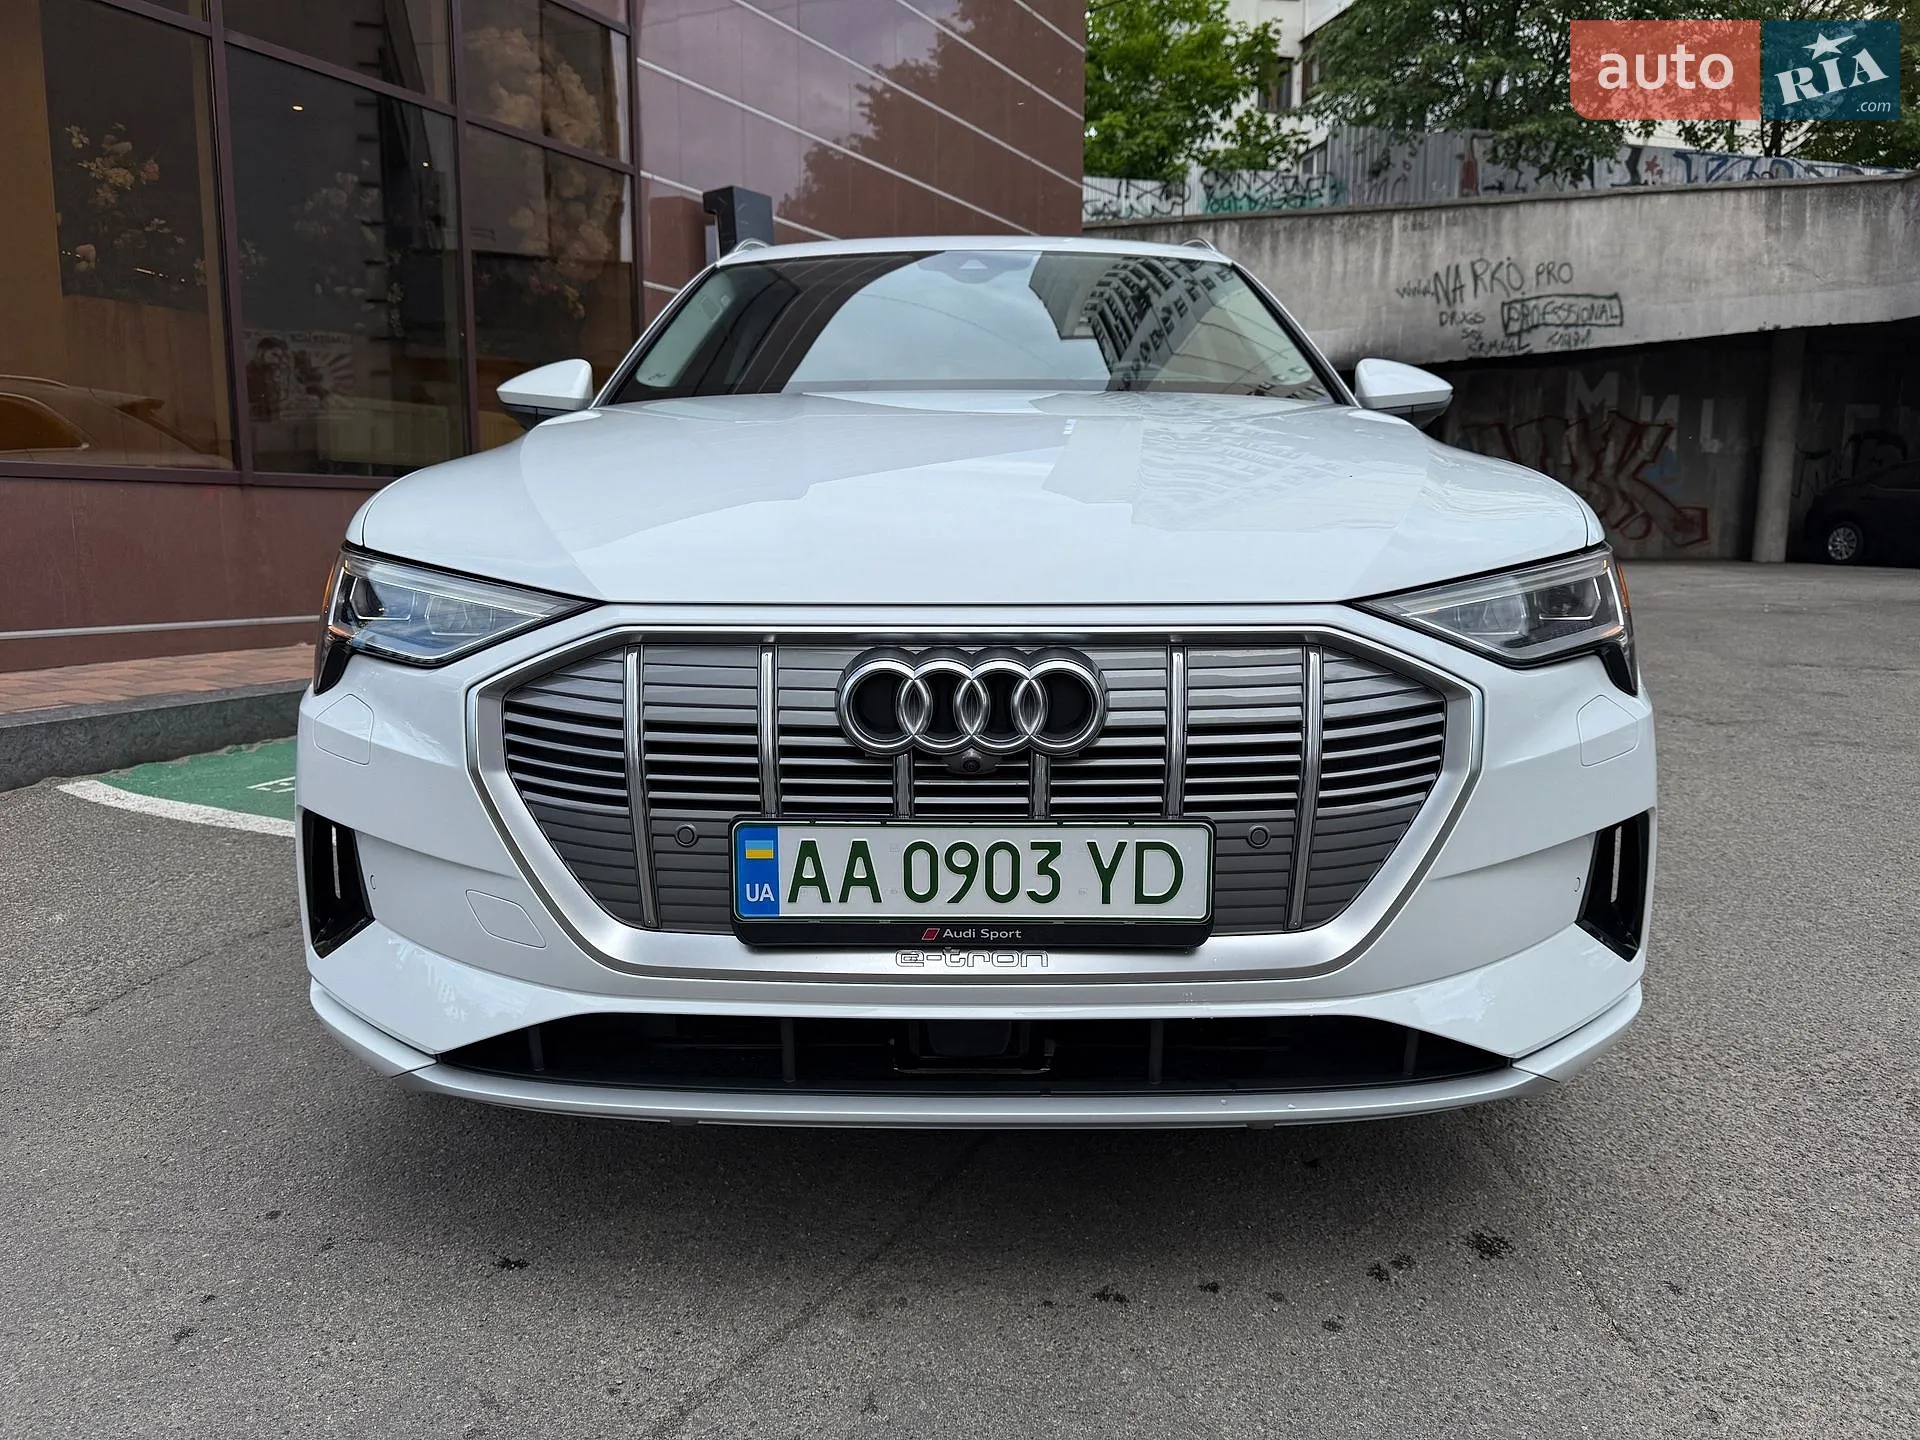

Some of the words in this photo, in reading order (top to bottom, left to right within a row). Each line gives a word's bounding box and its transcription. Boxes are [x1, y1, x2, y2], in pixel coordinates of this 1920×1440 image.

[1535, 261, 1574, 288] PRO
[787, 839, 883, 904] AA
[902, 840, 1063, 904] 0903
[1086, 840, 1186, 904] YD
[745, 883, 775, 902] UA
[942, 928, 976, 939] Audi
[980, 928, 1022, 941] Sport
[895, 947, 1049, 968] e-tron
